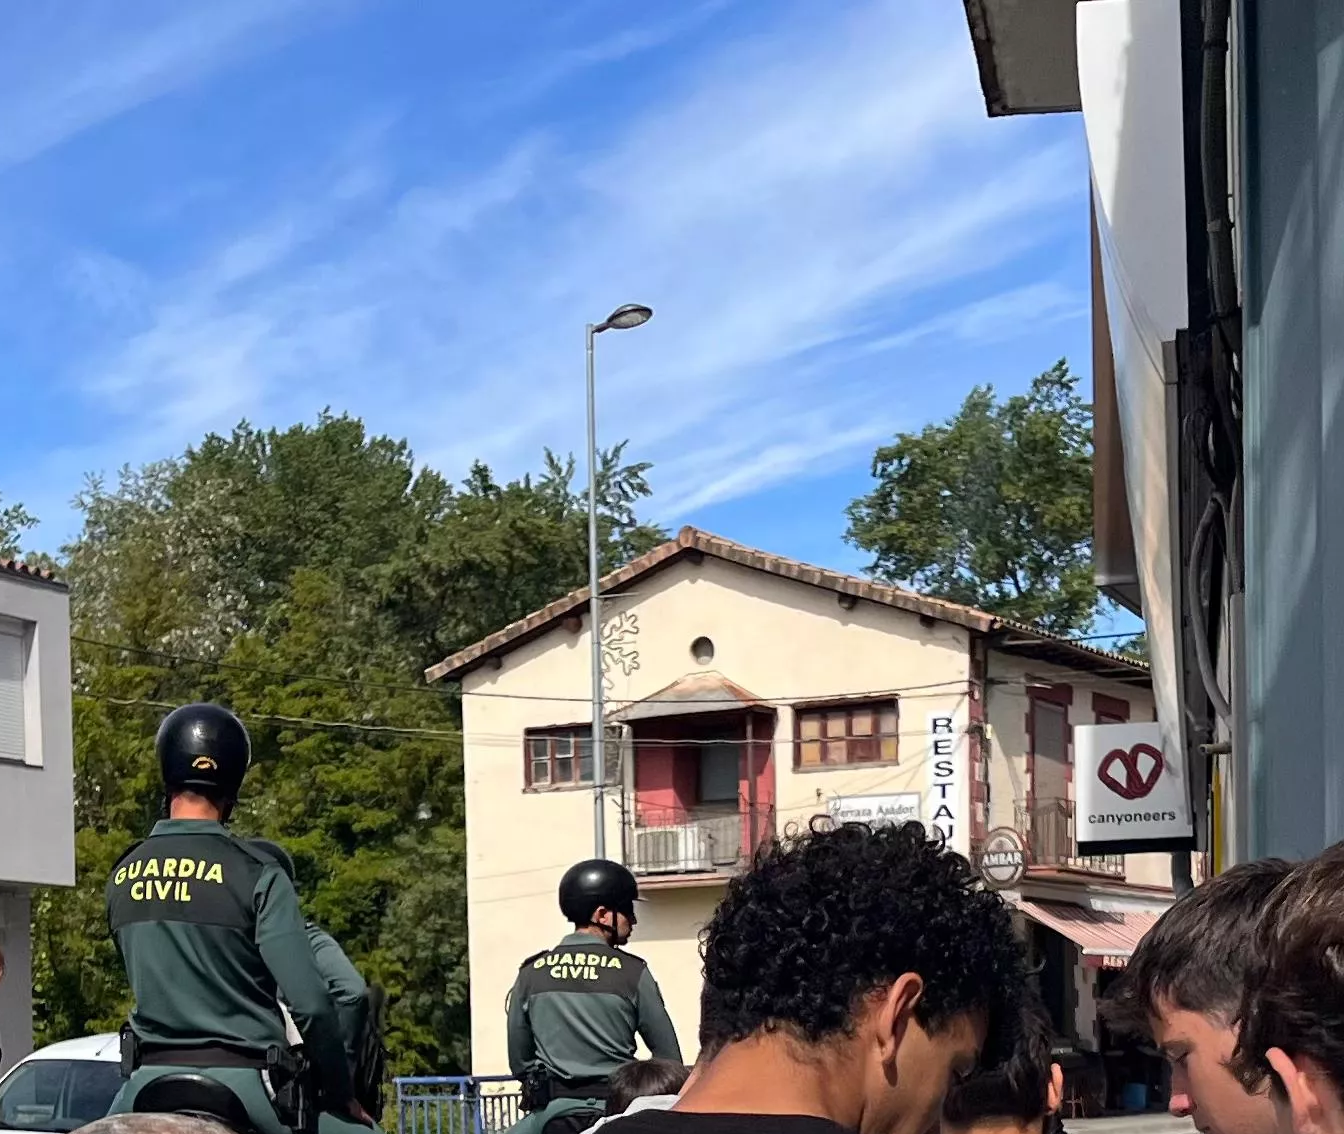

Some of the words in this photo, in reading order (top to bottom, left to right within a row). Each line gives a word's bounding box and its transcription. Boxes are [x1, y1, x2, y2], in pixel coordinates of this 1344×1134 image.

[837, 806, 872, 818] erraza
[1088, 809, 1176, 827] canyoneers
[114, 857, 224, 885] GUARDIA
[130, 880, 191, 902] CIVIL
[533, 952, 622, 969] GUARDIA
[549, 966, 599, 980] CIVIL
